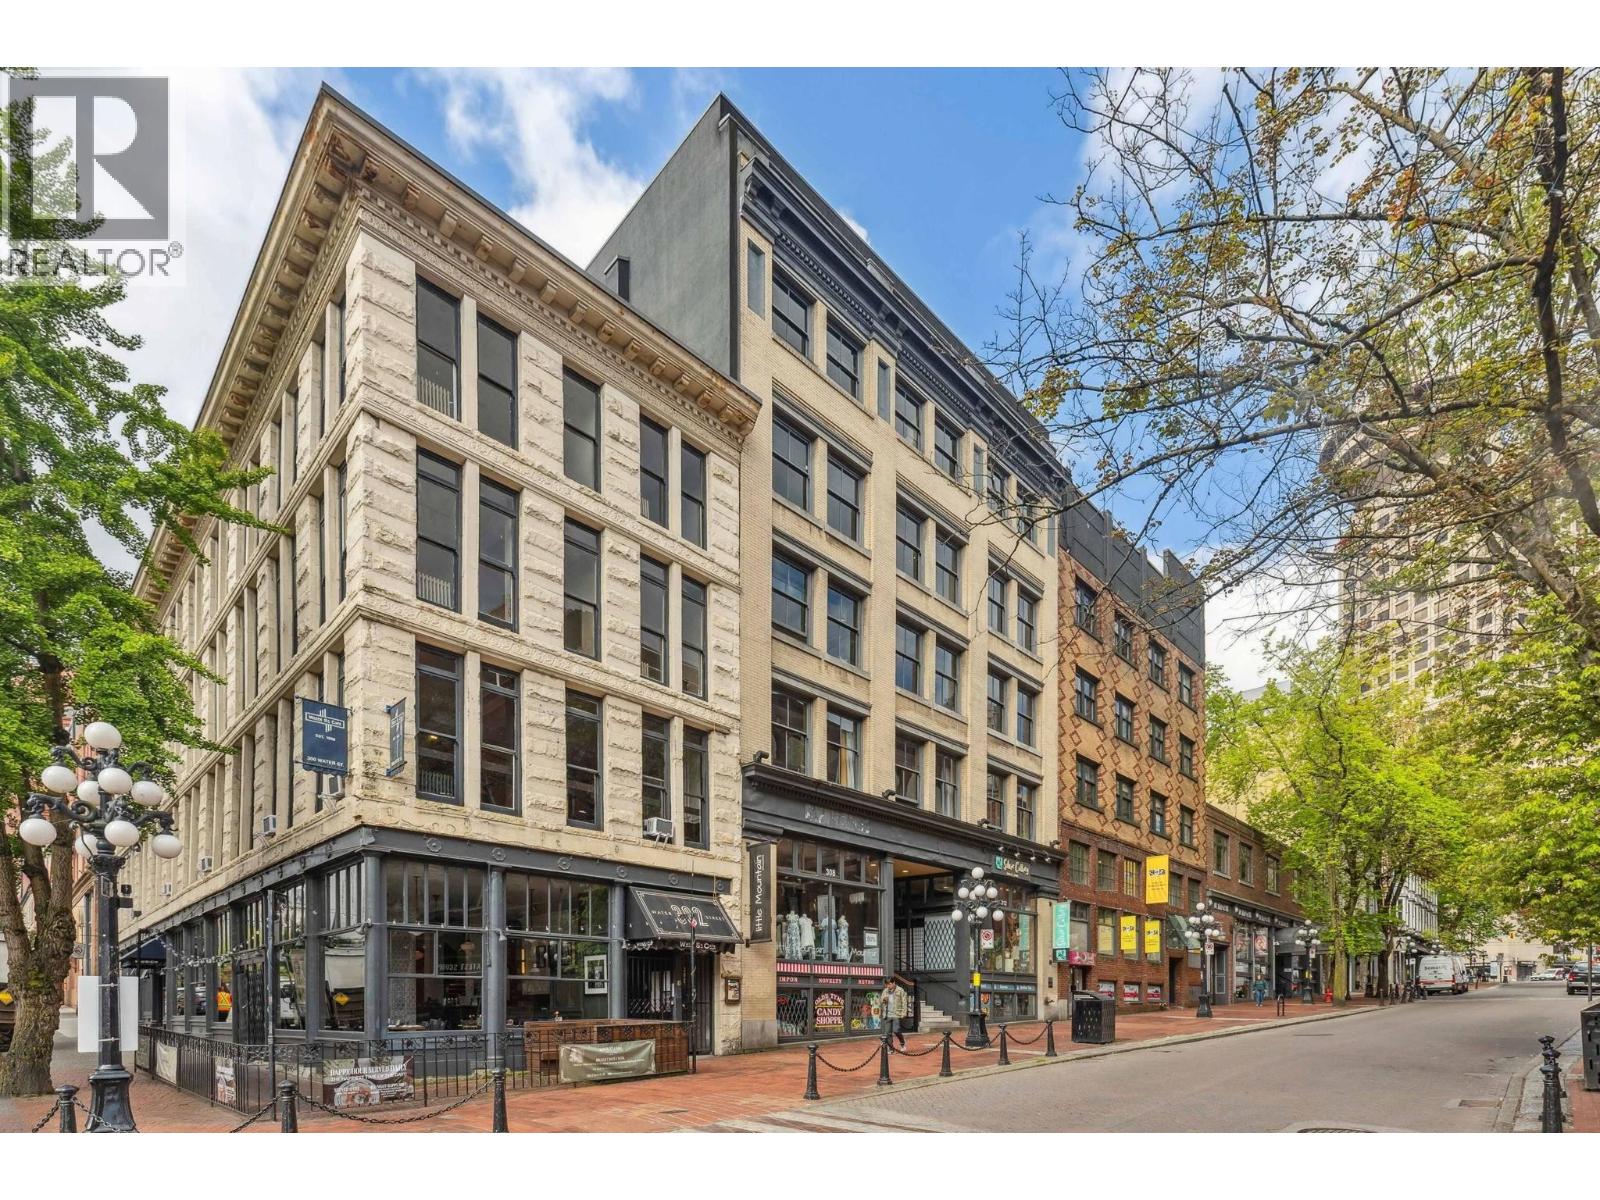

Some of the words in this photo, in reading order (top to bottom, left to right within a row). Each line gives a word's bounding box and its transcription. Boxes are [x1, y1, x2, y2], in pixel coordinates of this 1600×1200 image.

[317, 758, 336, 766] WATER
[755, 854, 765, 904] Mountain
[816, 1007, 842, 1016] CANDY
[816, 1016, 843, 1025] SHOPPE
